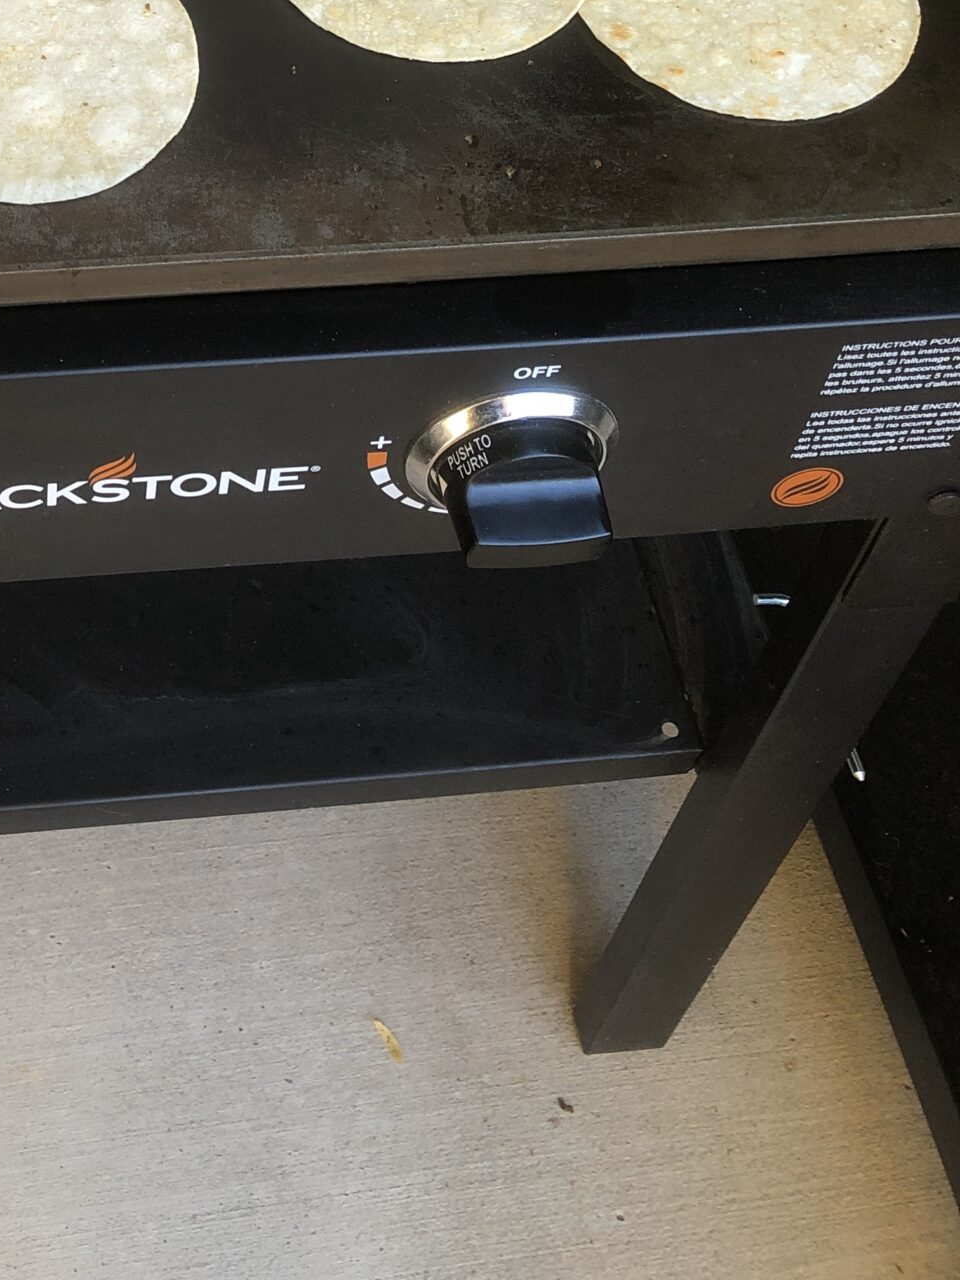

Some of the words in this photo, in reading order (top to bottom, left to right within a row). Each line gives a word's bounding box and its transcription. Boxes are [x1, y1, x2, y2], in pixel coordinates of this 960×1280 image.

[841, 339, 928, 352] INSTRUCTIONS
[837, 353, 864, 361] Lisez
[867, 351, 898, 359] toutes
[899, 355, 950, 365] l'allumage
[513, 364, 562, 380] OFF
[828, 372, 847, 380] pas
[850, 369, 874, 377] dans
[887, 373, 932, 383] attendez
[810, 406, 902, 418] INSTRUCCIONES
[903, 404, 920, 412] DE
[874, 412, 938, 422] instrucciones
[901, 420, 933, 428] ocurre
[447, 443, 474, 469] PUSH
[474, 434, 492, 450] TO
[790, 451, 818, 460] repita
[820, 447, 883, 457] instrucciones
[456, 453, 489, 480] TURN
